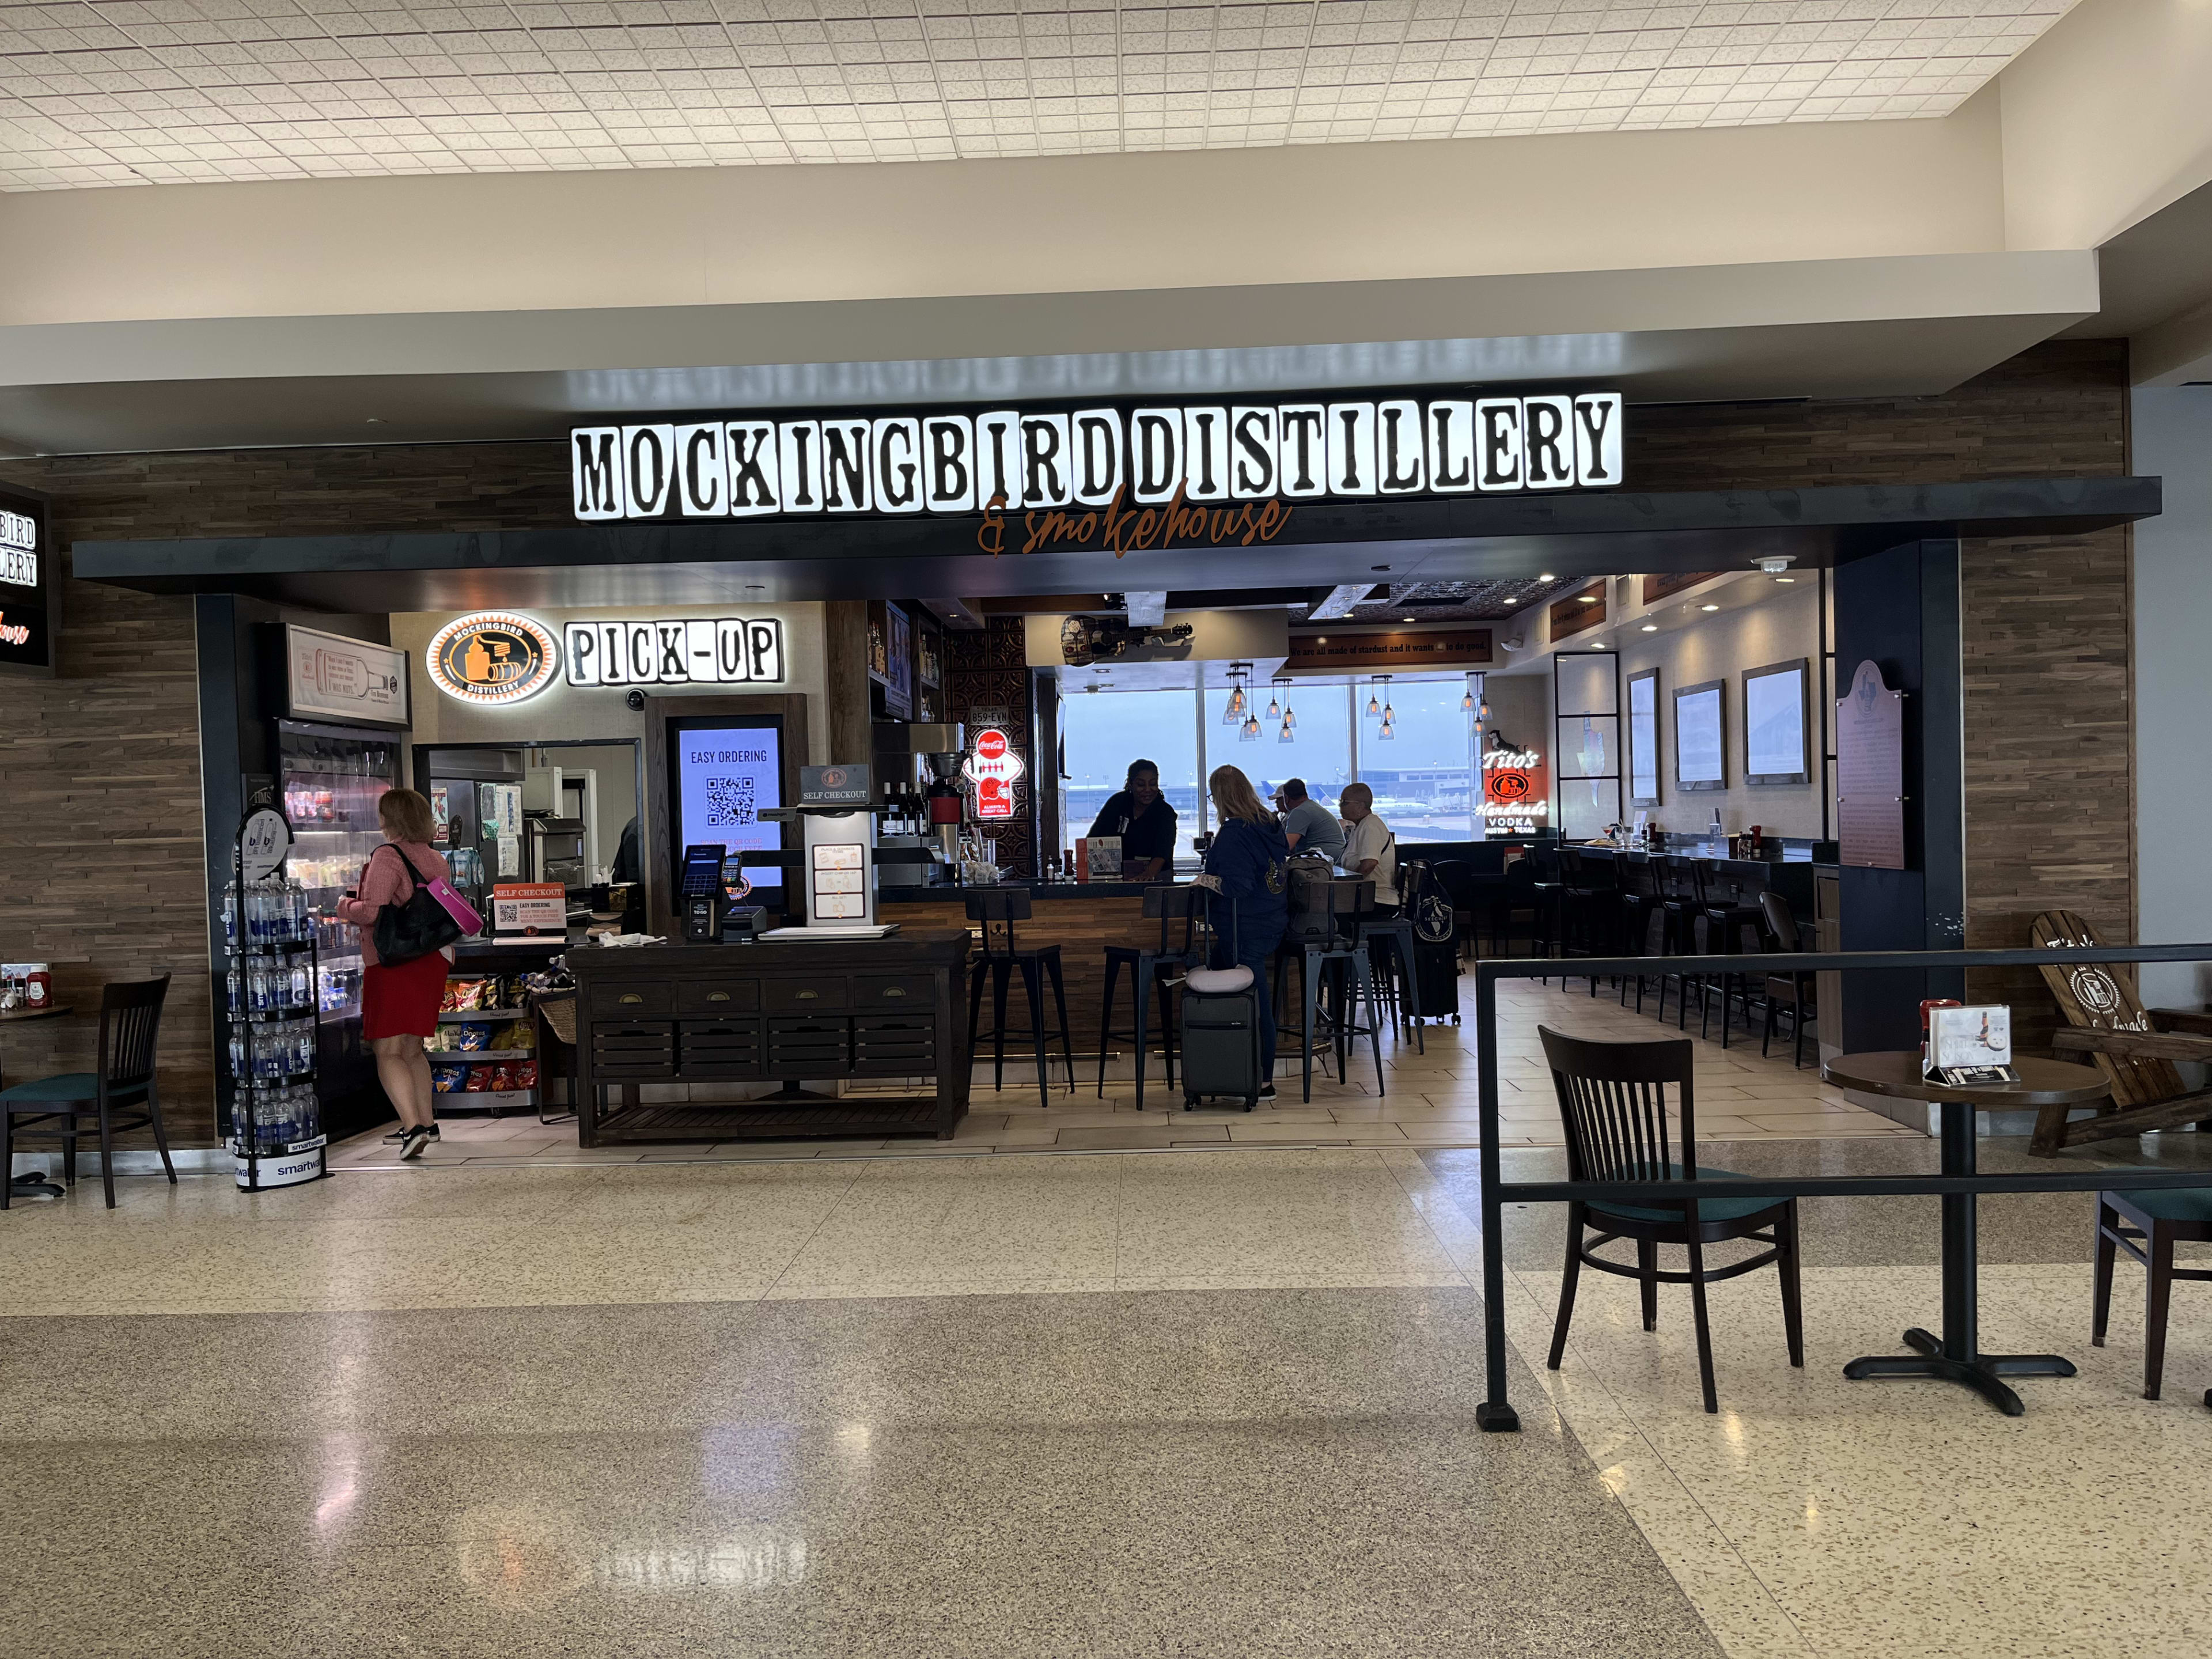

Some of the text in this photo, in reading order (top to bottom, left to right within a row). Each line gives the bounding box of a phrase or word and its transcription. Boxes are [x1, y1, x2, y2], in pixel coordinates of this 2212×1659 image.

[1022, 478, 1293, 559] smokehouse
[453, 622, 524, 641] MOCKINGBIRD
[571, 626, 773, 680] PICK-UP
[1290, 648, 1301, 656] We
[1317, 647, 1326, 655] all
[1328, 646, 1347, 655] made
[1350, 646, 1357, 654] of
[1358, 645, 1388, 654] stardust
[1389, 644, 1404, 653] and
[1406, 644, 1411, 652] it
[1412, 643, 1434, 652] wants
[1455, 642, 1464, 650] do
[1466, 642, 1487, 652] good.
[467, 681, 519, 694] DISTILLERY
[691, 750, 767, 764] EASY ORDERING
[1482, 749, 1540, 769] Tito's
[803, 790, 866, 800] SELF CHECKOUT
[1475, 800, 1546, 816] Handmade
[1488, 817, 1533, 827] VODKA
[518, 888, 562, 896] CHECKOUT
[291, 1137, 325, 1151] smartwater
